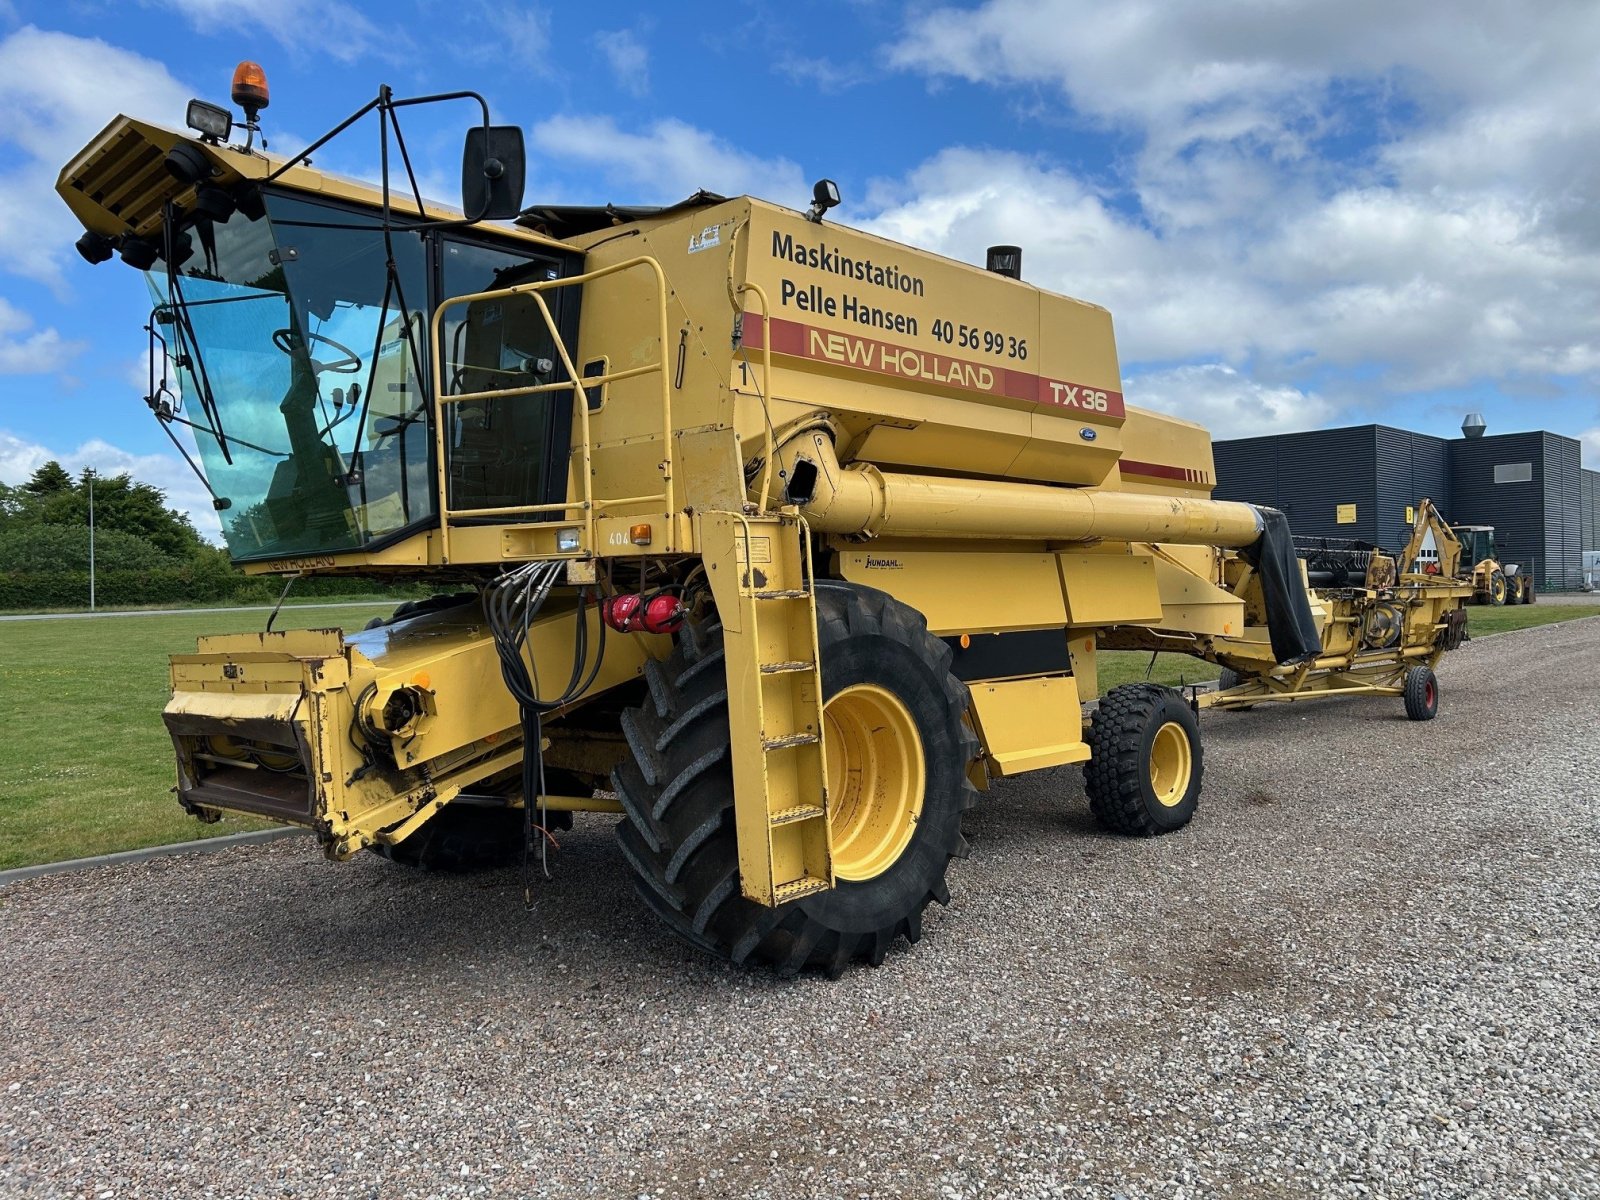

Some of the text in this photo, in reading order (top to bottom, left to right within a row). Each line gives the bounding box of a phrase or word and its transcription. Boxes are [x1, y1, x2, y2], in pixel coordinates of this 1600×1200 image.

[772, 230, 924, 297] Maskinstation
[781, 279, 1028, 360] Pelle Hansen 40 56 99 36
[810, 329, 994, 390] NEW HOLLAND
[1050, 381, 1108, 412] TX 36
